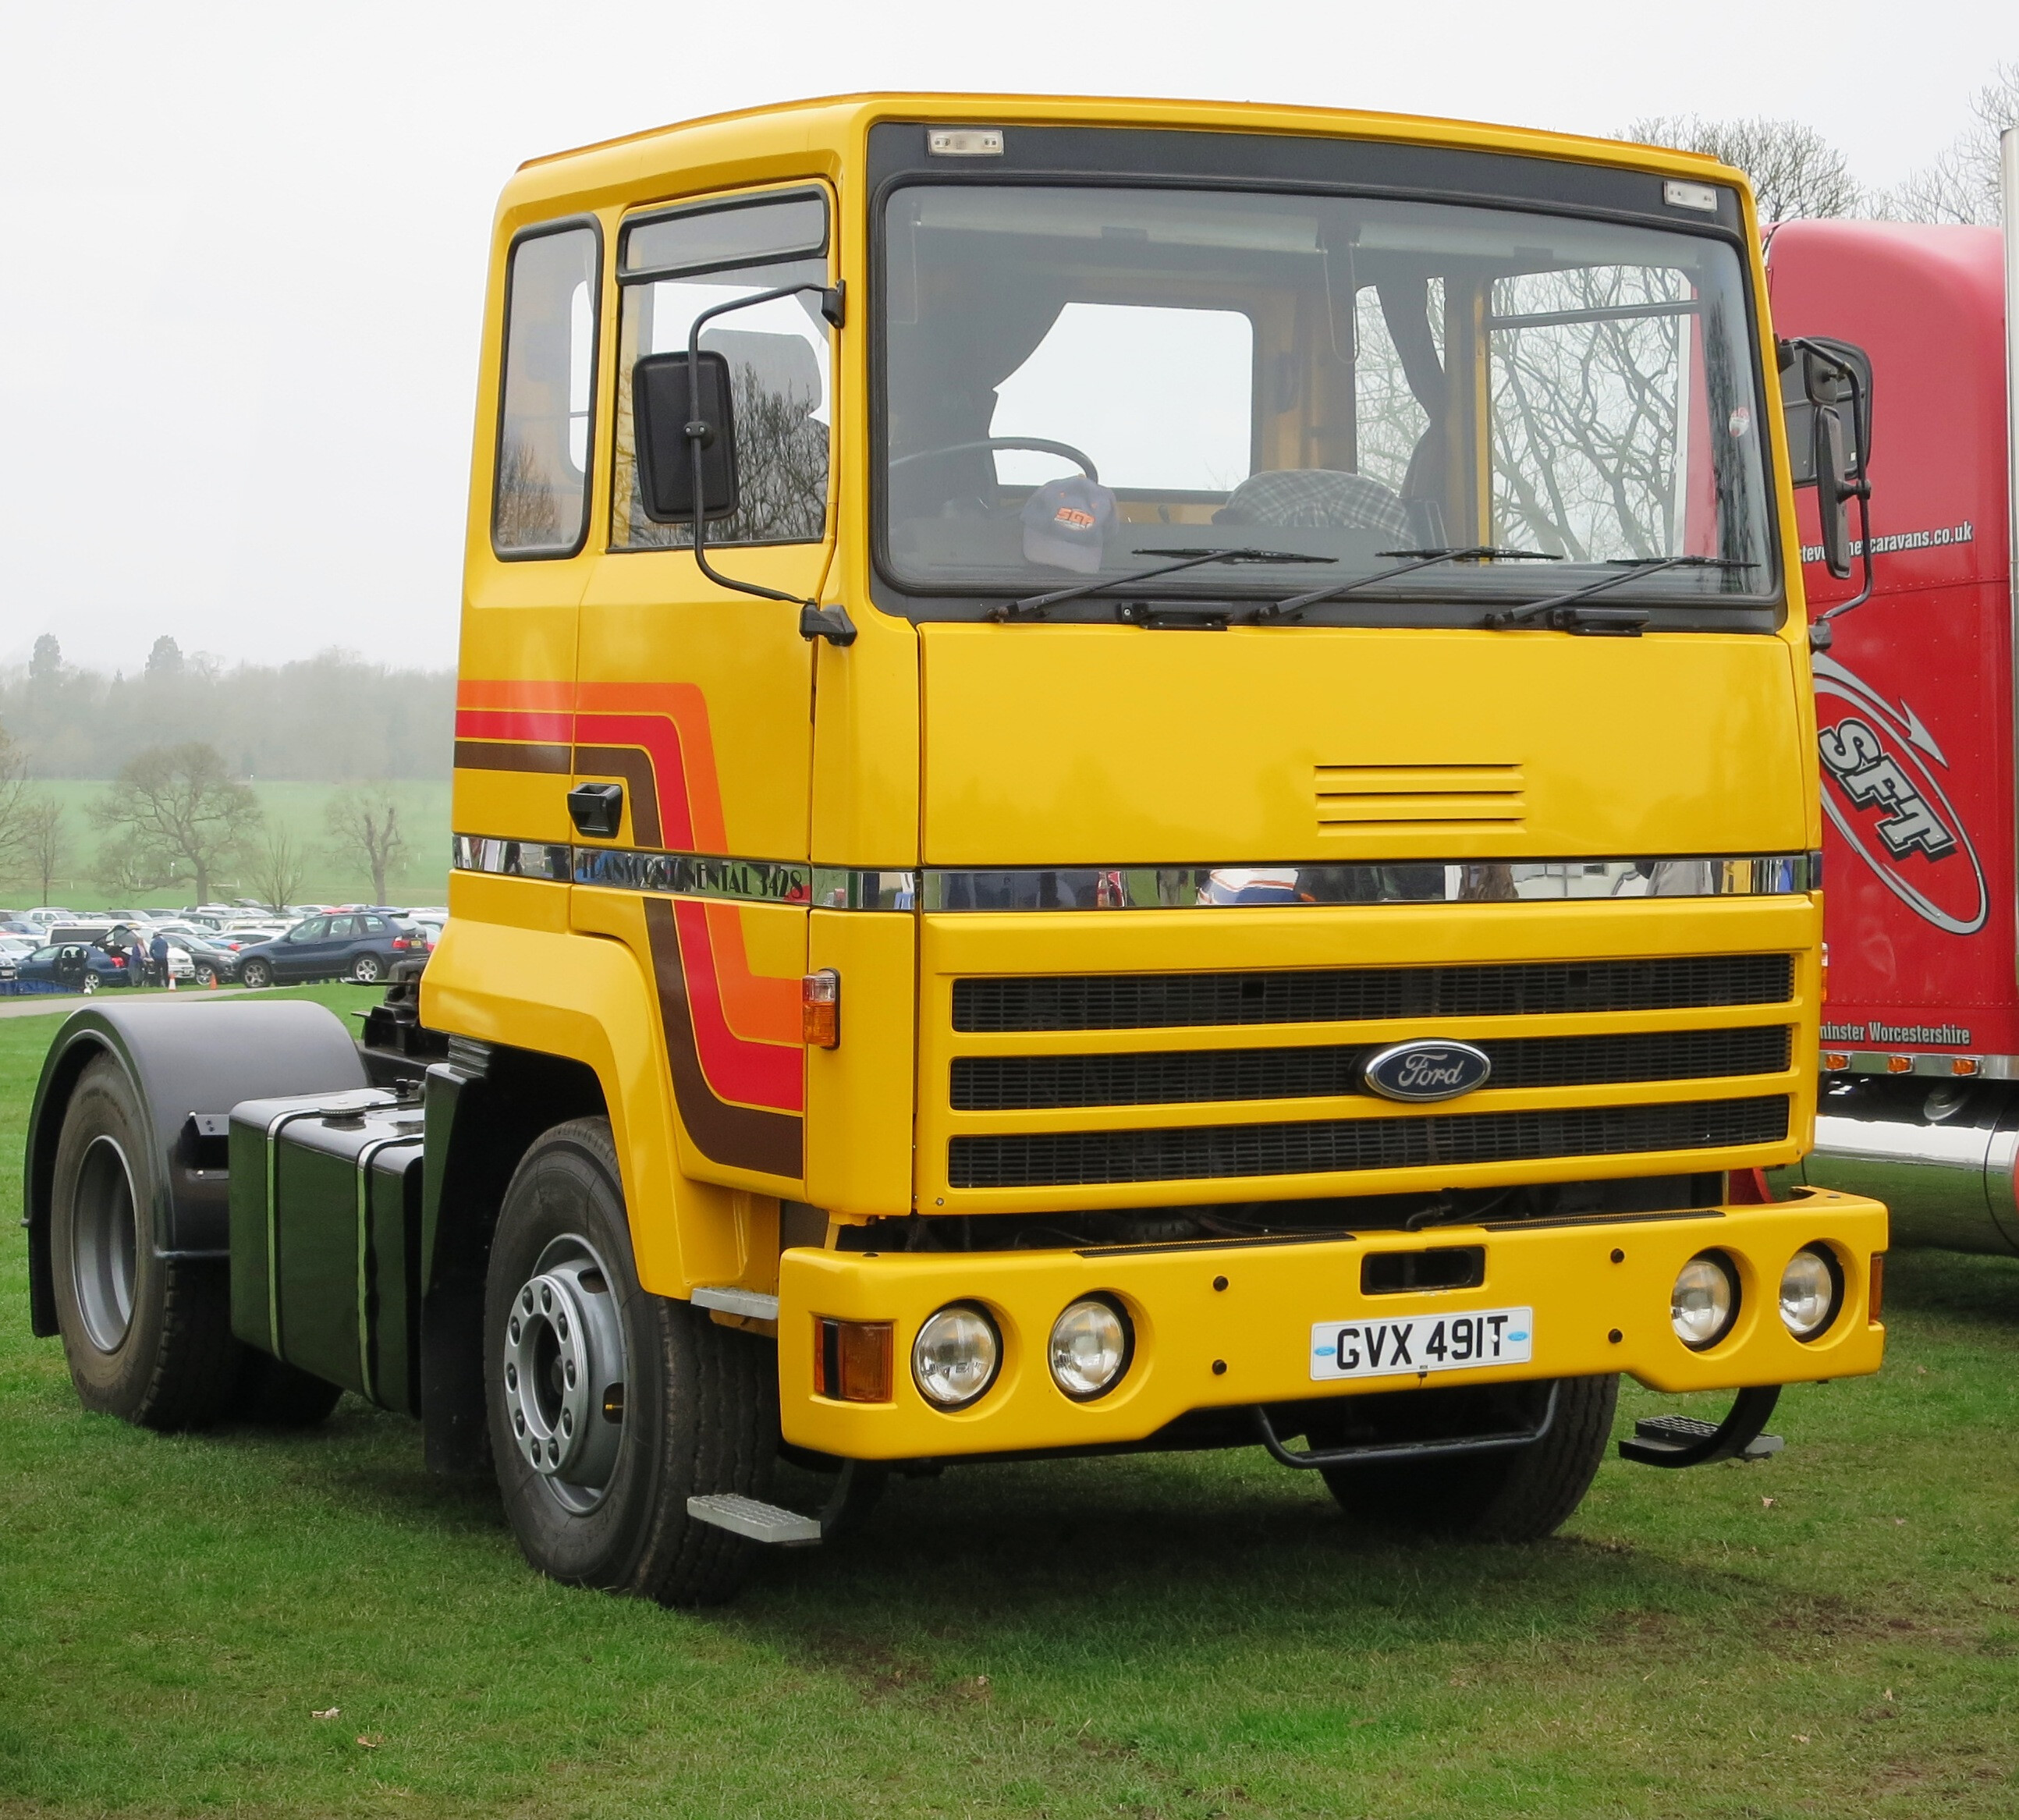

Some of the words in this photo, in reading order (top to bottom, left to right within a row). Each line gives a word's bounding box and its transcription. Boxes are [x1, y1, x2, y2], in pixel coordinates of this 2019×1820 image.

[1818, 717, 1957, 860] SFT
[759, 866, 804, 899] 3428
[1868, 1021, 1971, 1045] Worcestershire
[1397, 1053, 1465, 1087] Ford
[1336, 1323, 1414, 1370] GVX
[1425, 1314, 1509, 1362] 491T
